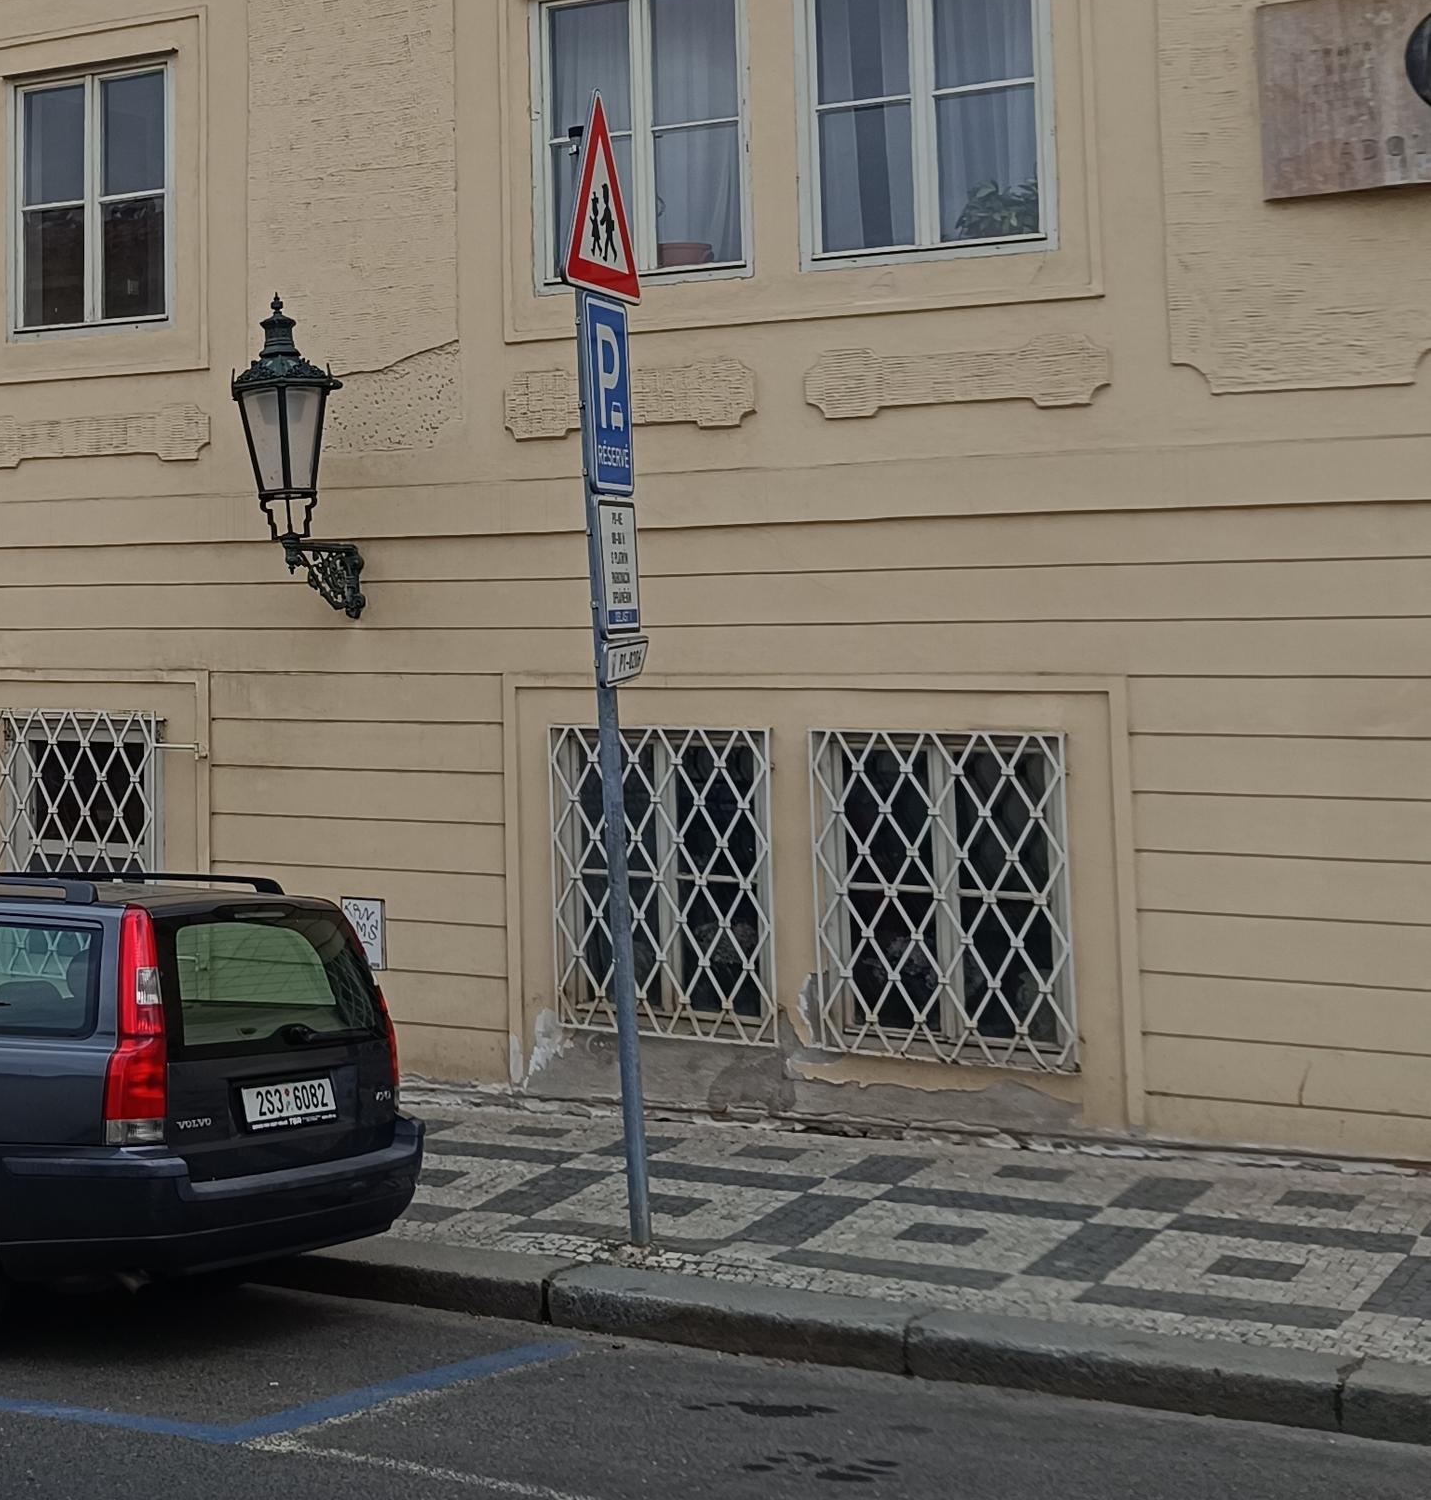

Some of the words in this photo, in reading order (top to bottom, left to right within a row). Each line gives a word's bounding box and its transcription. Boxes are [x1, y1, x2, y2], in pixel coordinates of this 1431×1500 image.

[596, 323, 620, 428] P
[598, 440, 630, 468] RÉSERVÉ
[256, 1090, 284, 1116] 2S3
[293, 1083, 329, 1110] 6082
[176, 1117, 212, 1130] VOLVO
